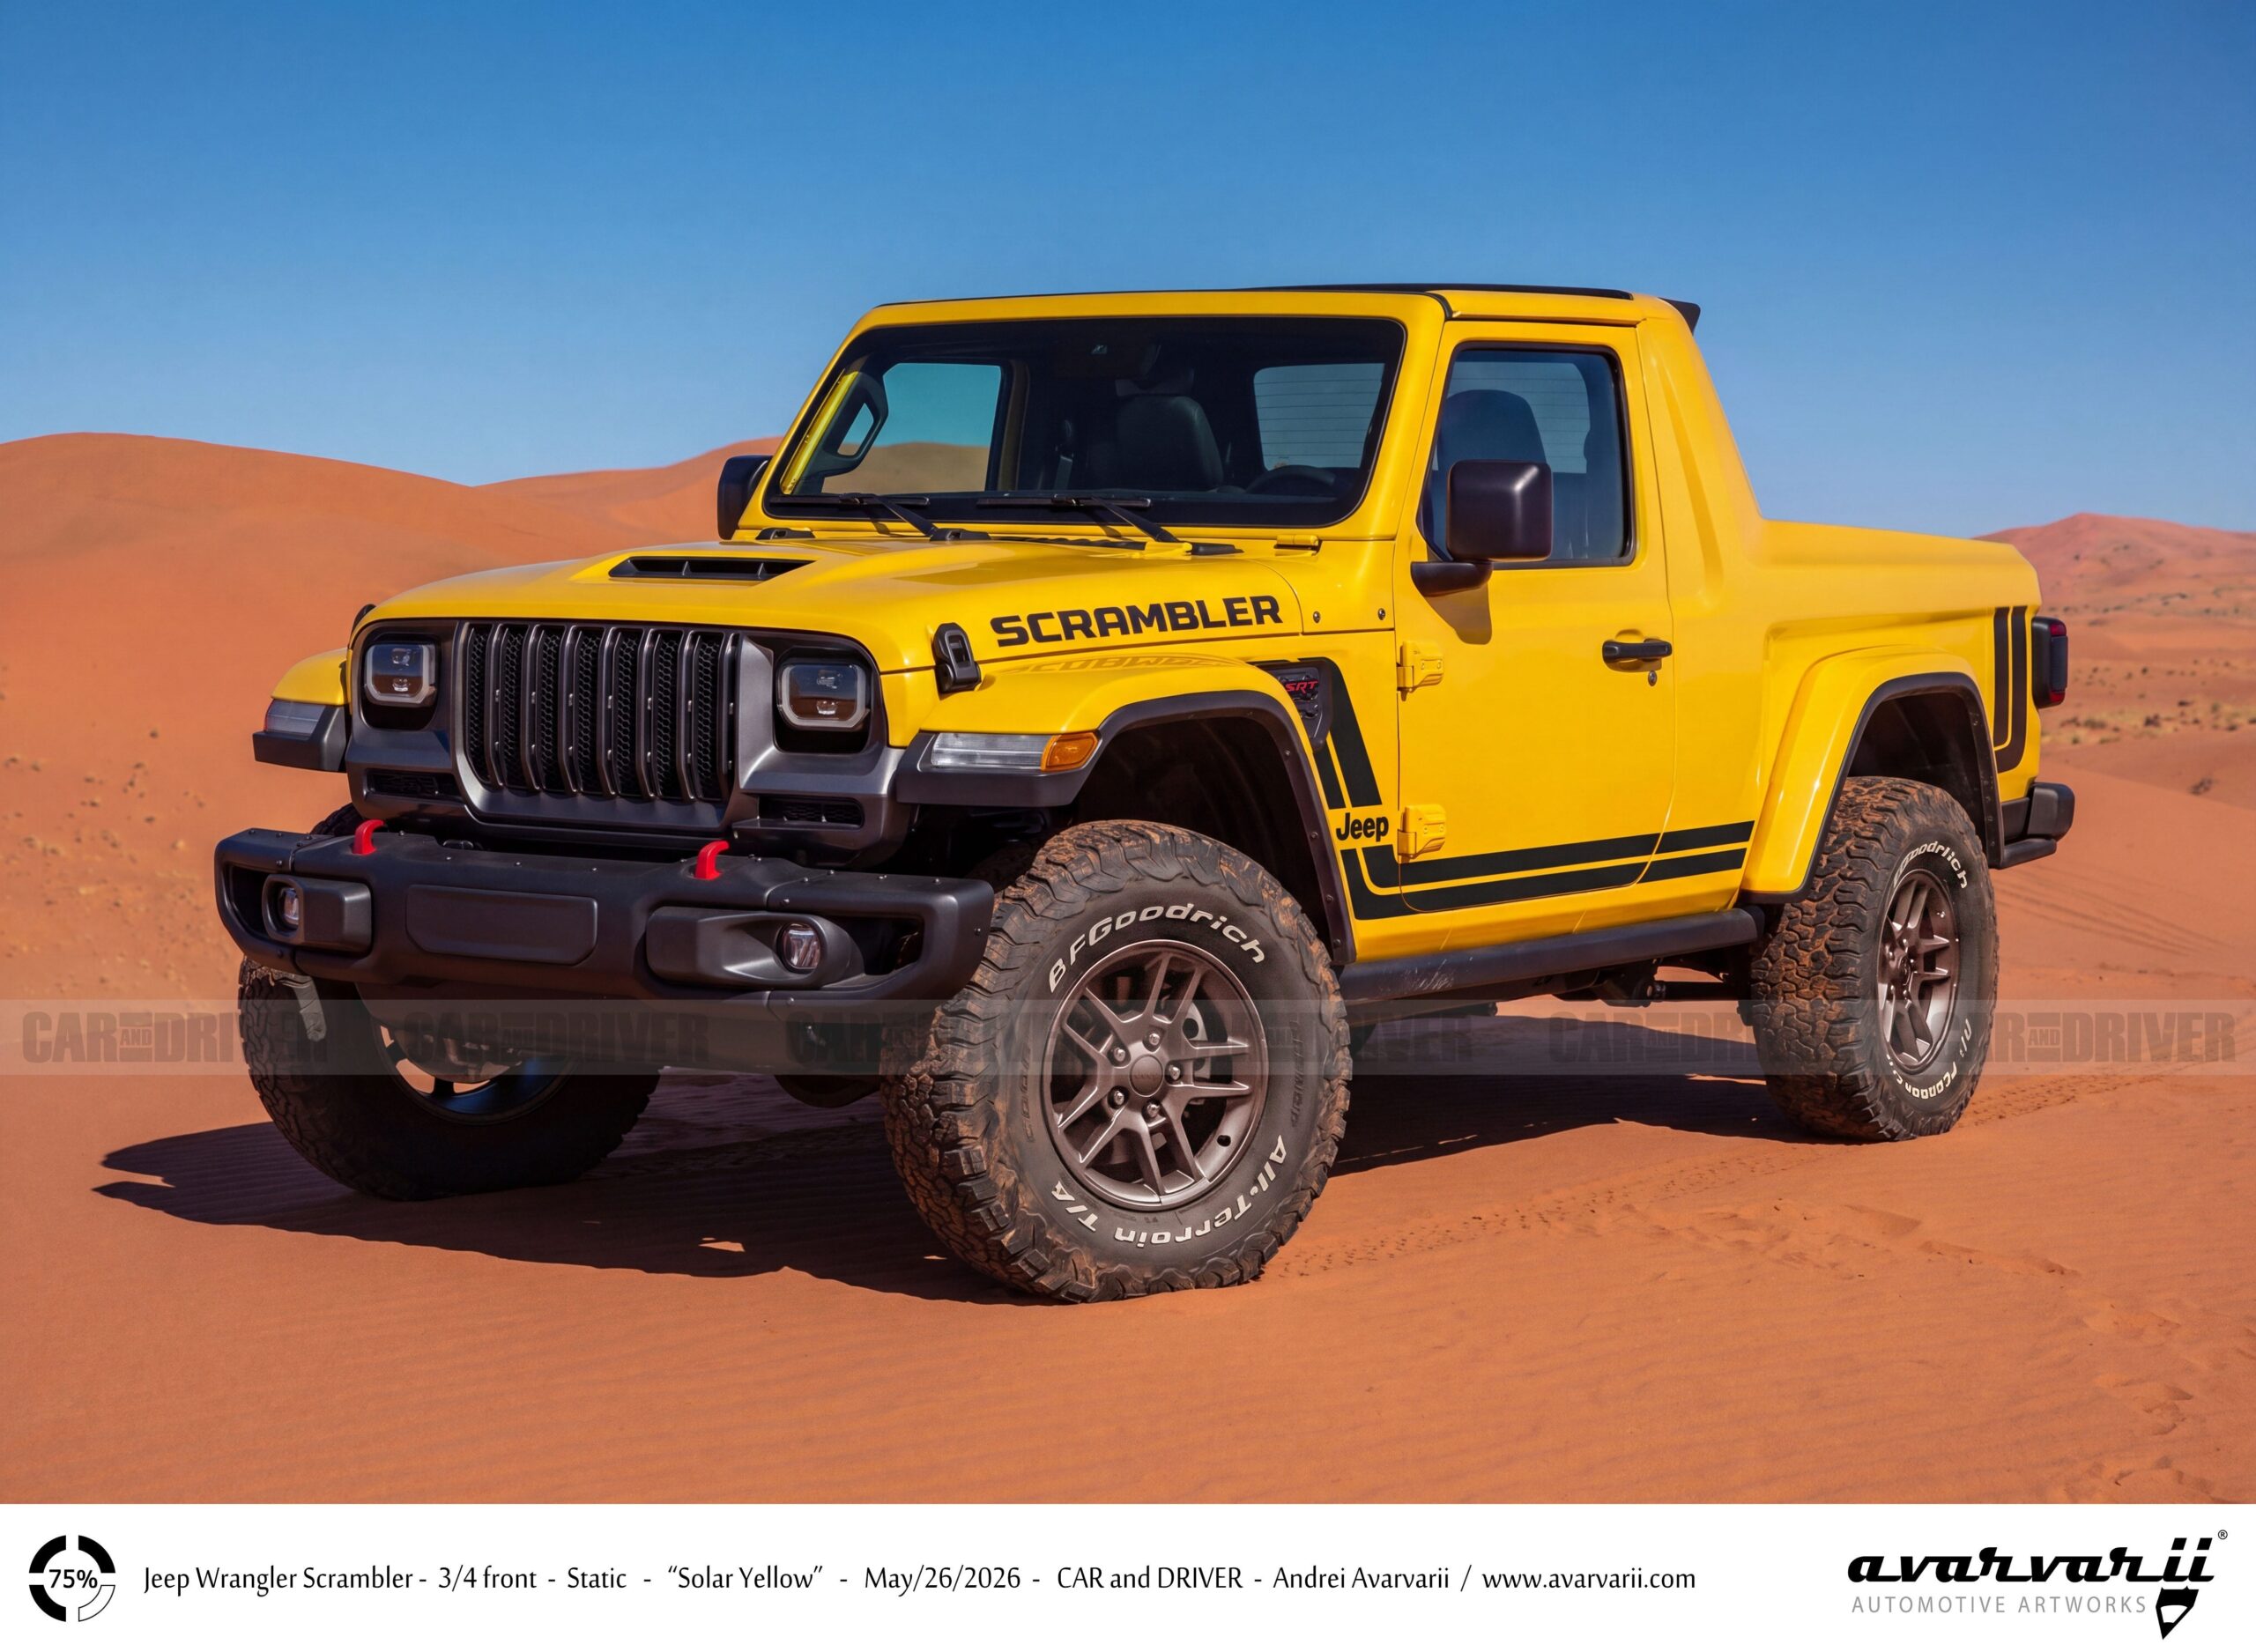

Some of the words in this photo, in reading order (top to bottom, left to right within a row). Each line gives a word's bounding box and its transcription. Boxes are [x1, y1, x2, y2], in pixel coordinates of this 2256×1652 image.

[990, 595, 1284, 647] SCRAMBLER
[1285, 681, 1319, 694] SRT
[1336, 812, 1389, 842] Jeep
[1049, 903, 1265, 993] BFGoodrich
[1051, 1181, 1097, 1232] T/A
